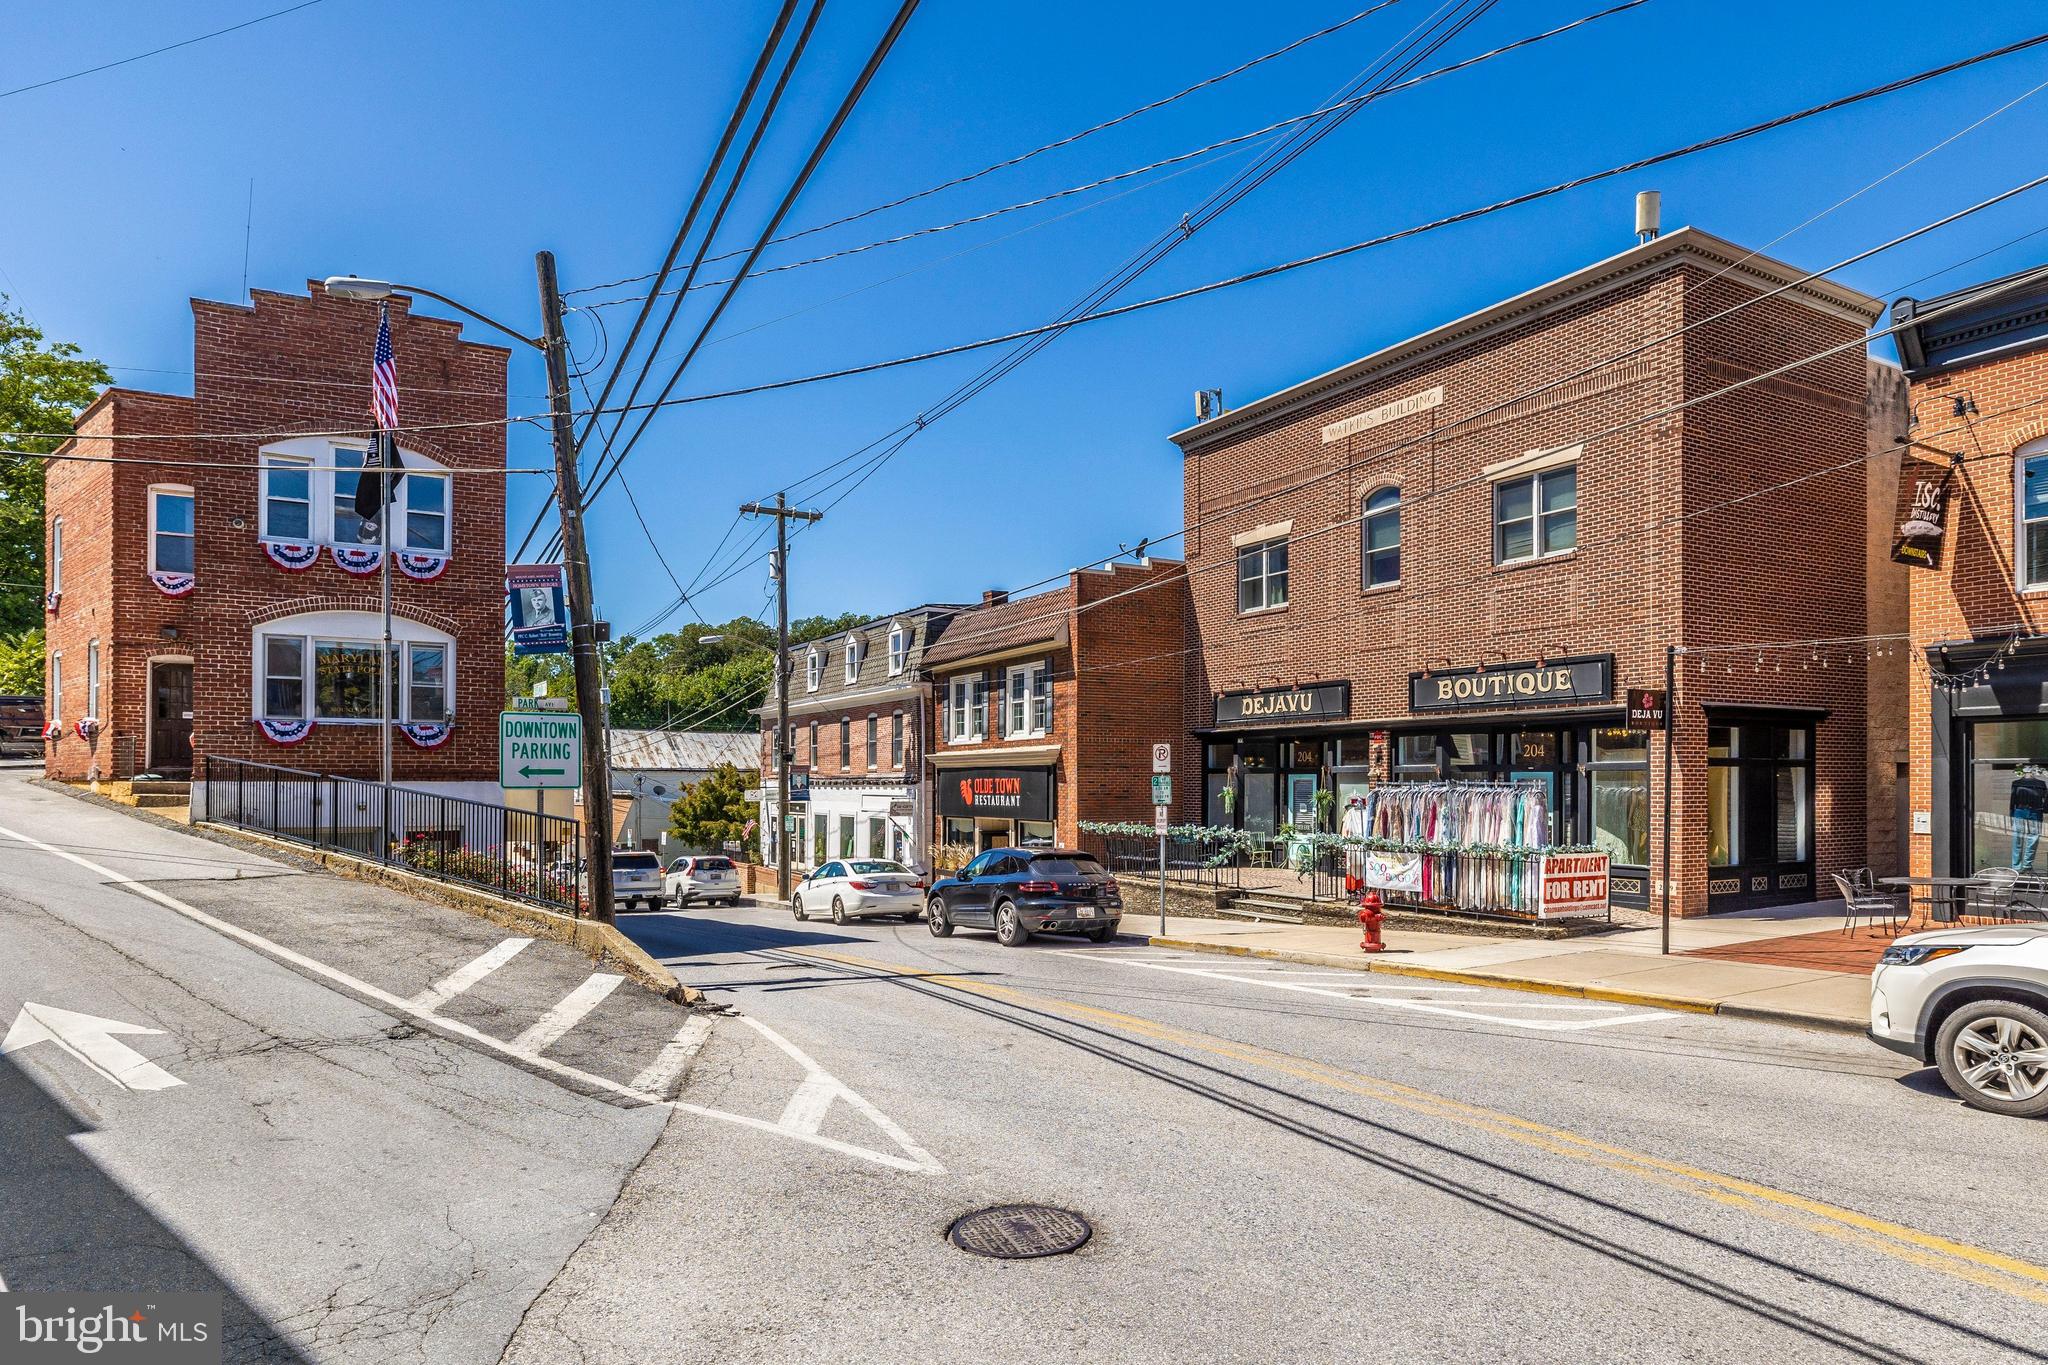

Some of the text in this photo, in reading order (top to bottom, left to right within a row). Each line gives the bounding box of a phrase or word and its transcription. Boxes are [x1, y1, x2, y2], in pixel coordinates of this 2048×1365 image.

[1329, 391, 1436, 437] WATKINS BUILDING
[1910, 508, 1939, 524] DISTILLERY
[1901, 545, 1927, 558] DOWNSTAIRS
[320, 666, 353, 675] STATE
[1438, 669, 1571, 700] BOUTIQUE
[518, 698, 539, 709] PARK
[1241, 693, 1312, 715] DEJAVU
[1632, 709, 1663, 719] DEJA VU
[505, 721, 576, 738] DOWNTOWN
[512, 742, 570, 760] PARKING
[1298, 751, 1312, 762] 204
[1523, 744, 1545, 757] 204
[974, 778, 1021, 794] OLDE TOWN
[975, 795, 1020, 807] RESTAURANT
[1544, 856, 1608, 874] APARTMENT
[1546, 879, 1606, 900] FOR RENT
